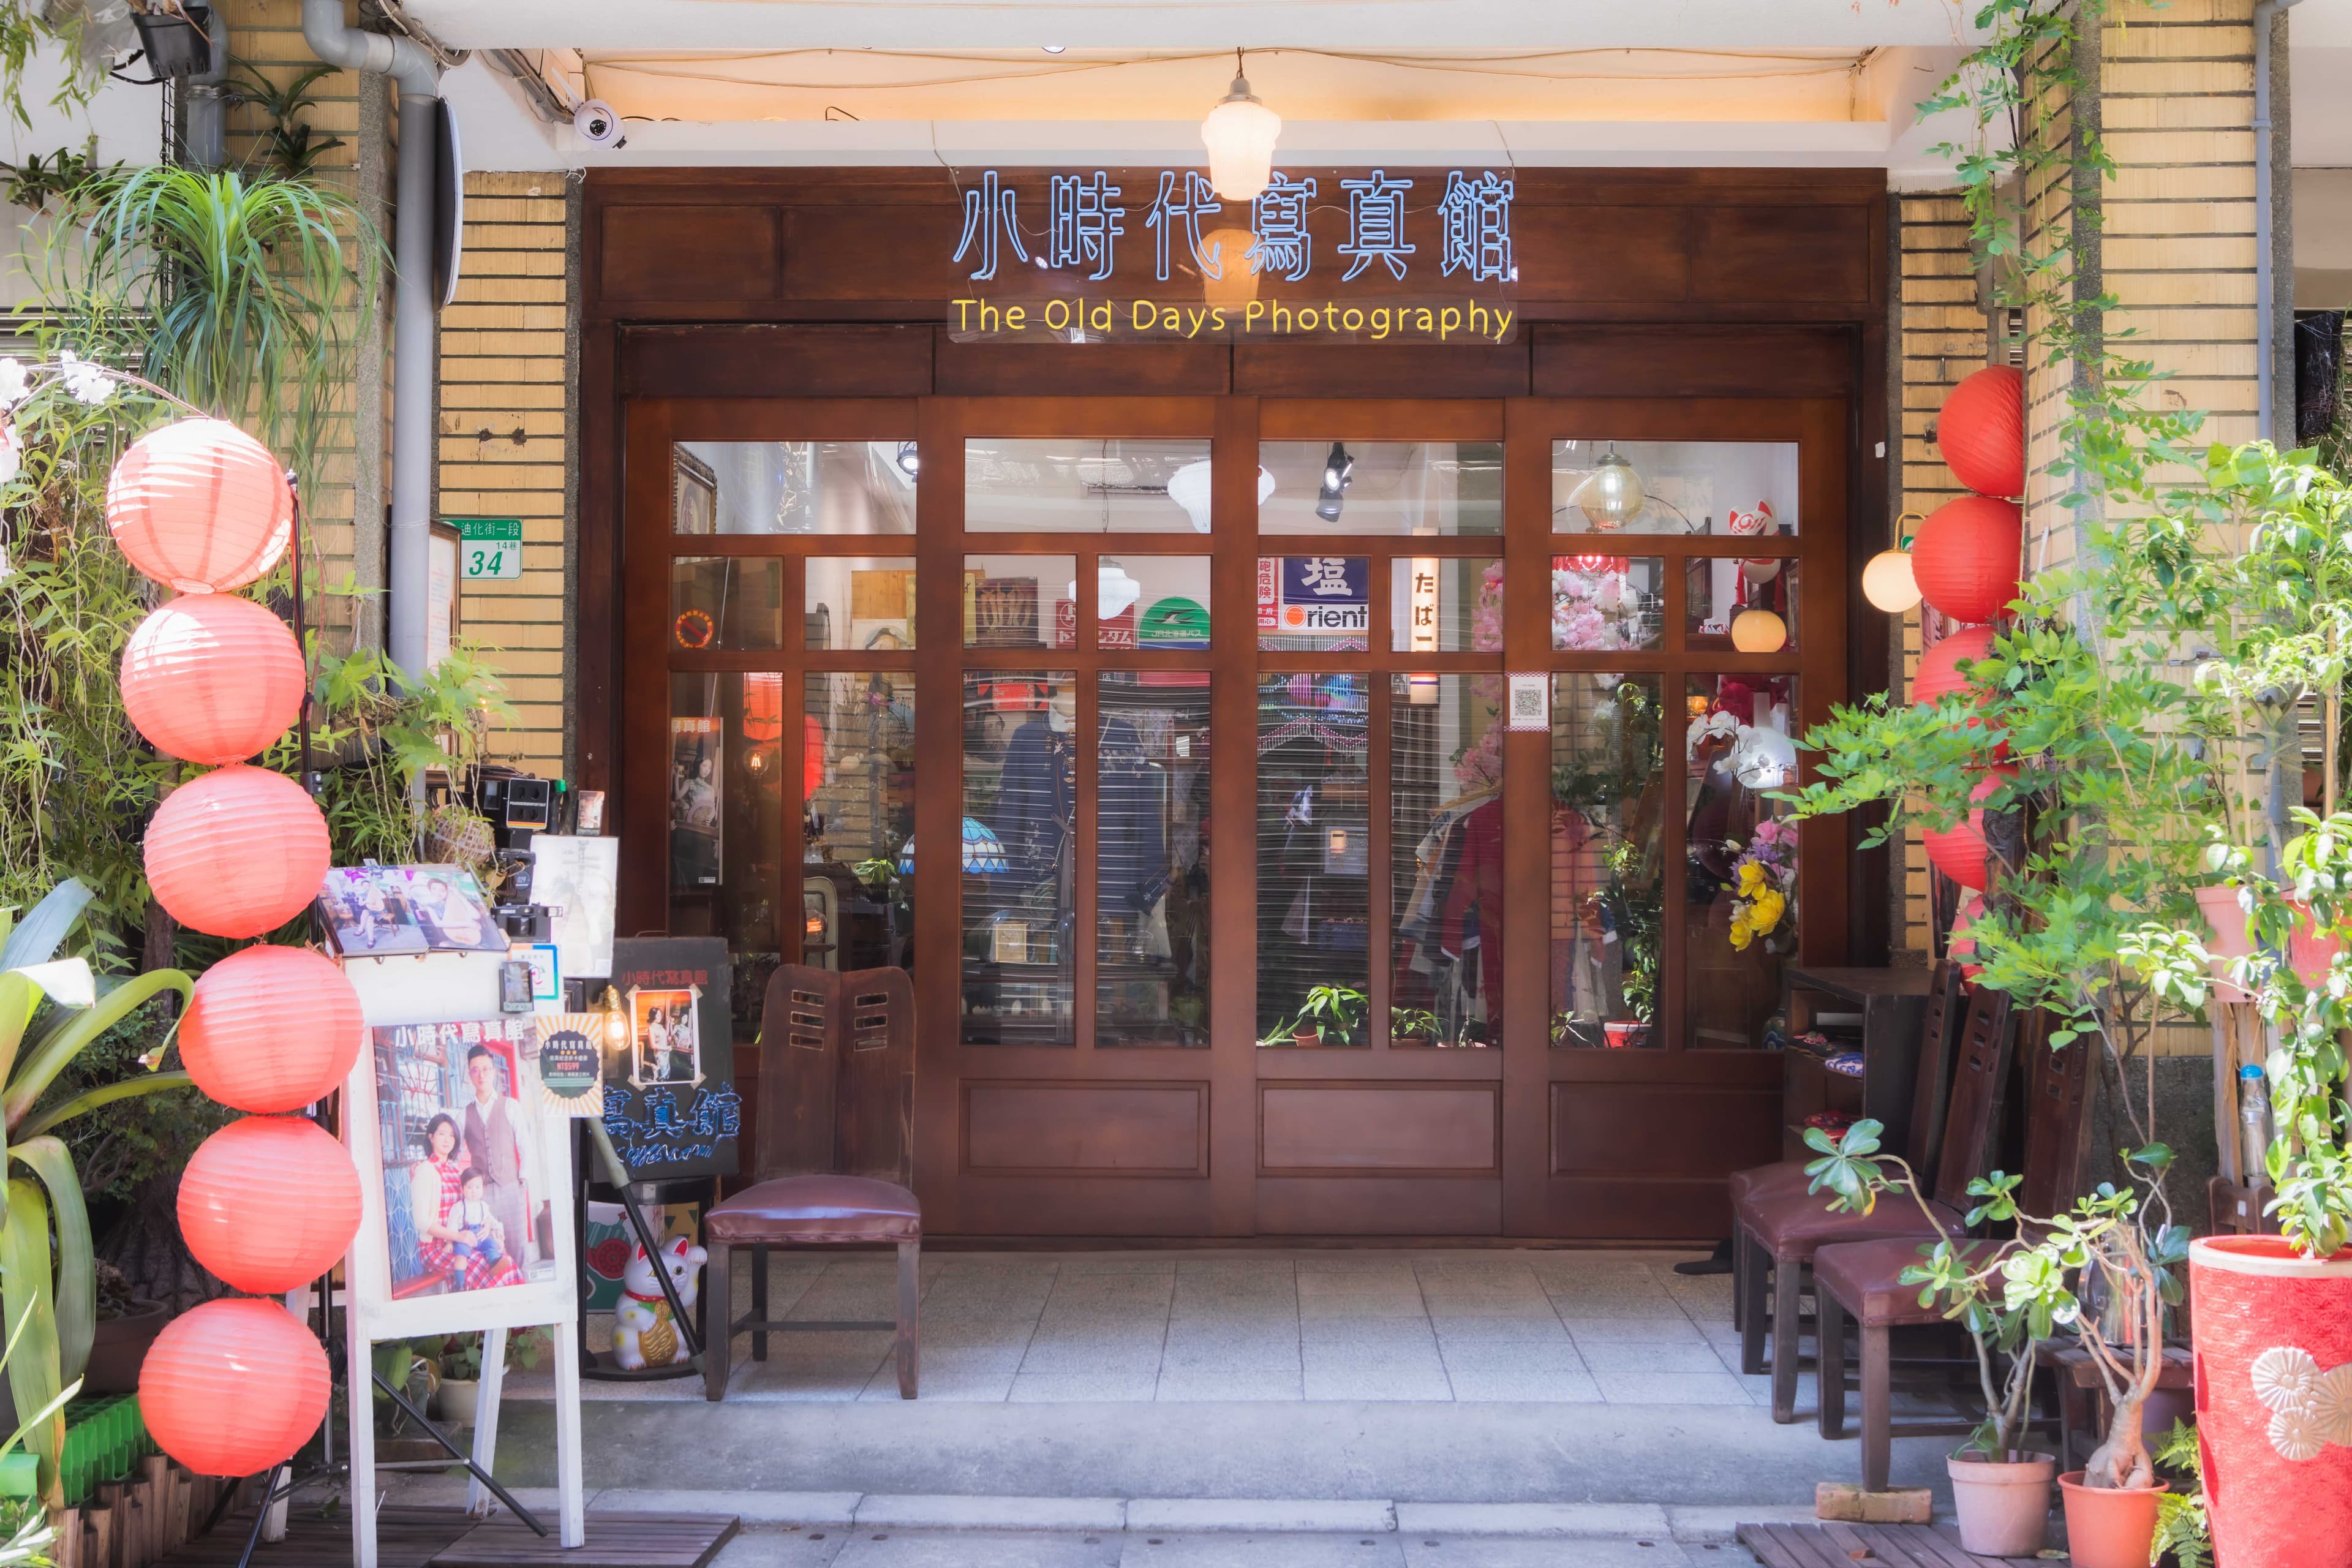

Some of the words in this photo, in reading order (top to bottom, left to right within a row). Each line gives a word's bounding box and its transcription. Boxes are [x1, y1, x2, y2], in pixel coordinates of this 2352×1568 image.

[952, 170, 1515, 283] 小時代寫真館
[951, 298, 1027, 332] The
[1044, 296, 1112, 332] Old
[1132, 299, 1226, 339] Days
[1245, 298, 1513, 341] Photography
[461, 522, 519, 537] 迪化街一段
[496, 541, 518, 550] 14巷
[469, 551, 503, 576] 34
[1258, 557, 1272, 598] 砲危険
[394, 1019, 524, 1047] 小時代寫真館
